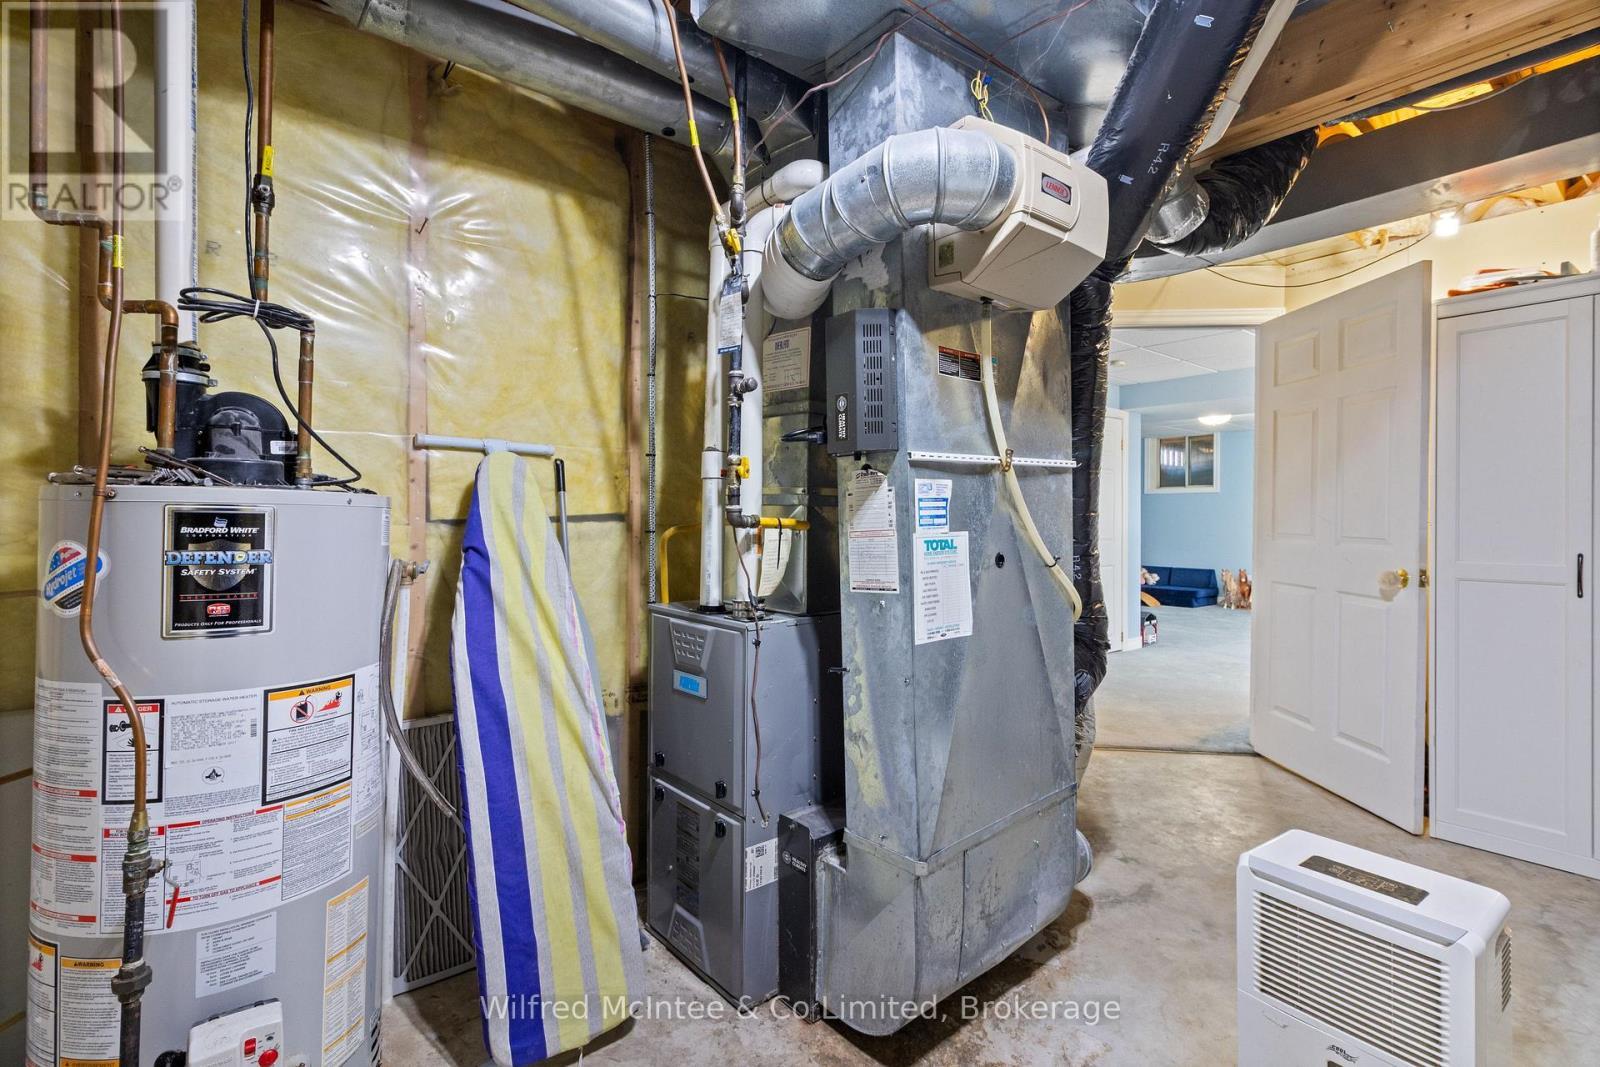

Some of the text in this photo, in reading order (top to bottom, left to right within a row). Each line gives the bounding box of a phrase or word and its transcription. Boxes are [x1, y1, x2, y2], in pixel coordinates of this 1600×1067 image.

[1147, 142, 1170, 174] R-4.2
[924, 539, 957, 551] TOTAL
[164, 550, 272, 566] DEFENDER
[306, 685, 331, 695] WARNING
